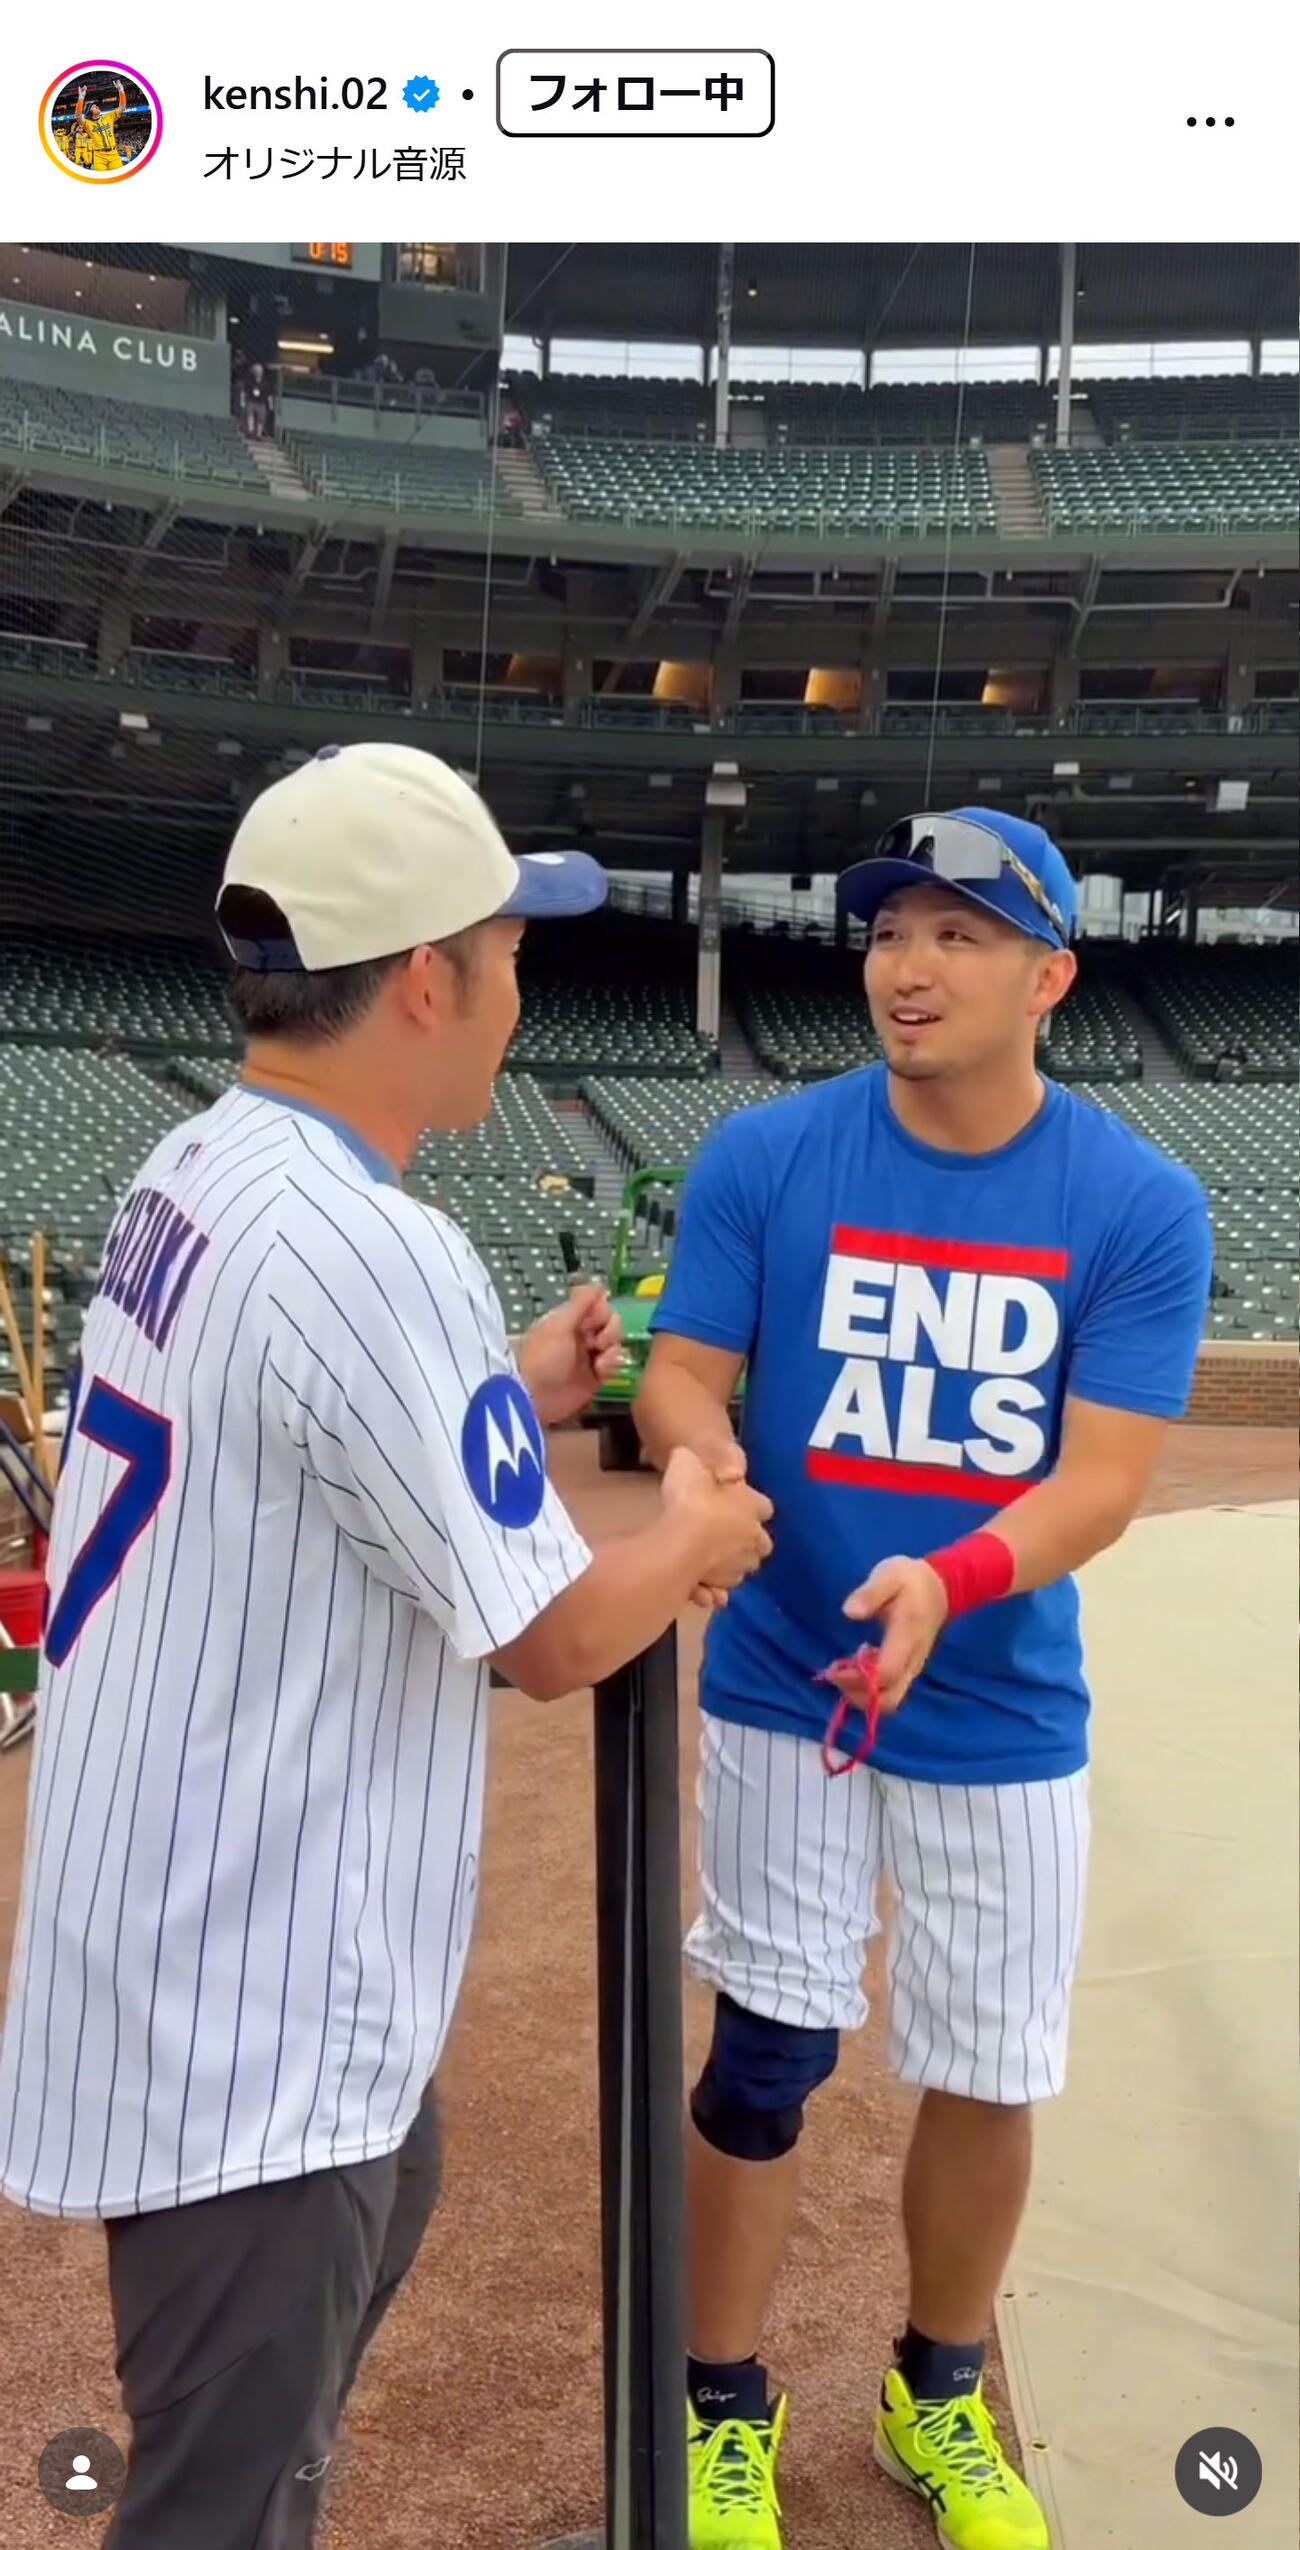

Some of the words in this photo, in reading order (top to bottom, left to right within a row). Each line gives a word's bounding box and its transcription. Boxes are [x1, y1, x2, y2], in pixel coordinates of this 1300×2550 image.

[113, 337, 197, 371] CLUB
[818, 1253, 1059, 1376] END
[807, 1357, 1046, 1476] ALS
[44, 1370, 172, 1669] 7
